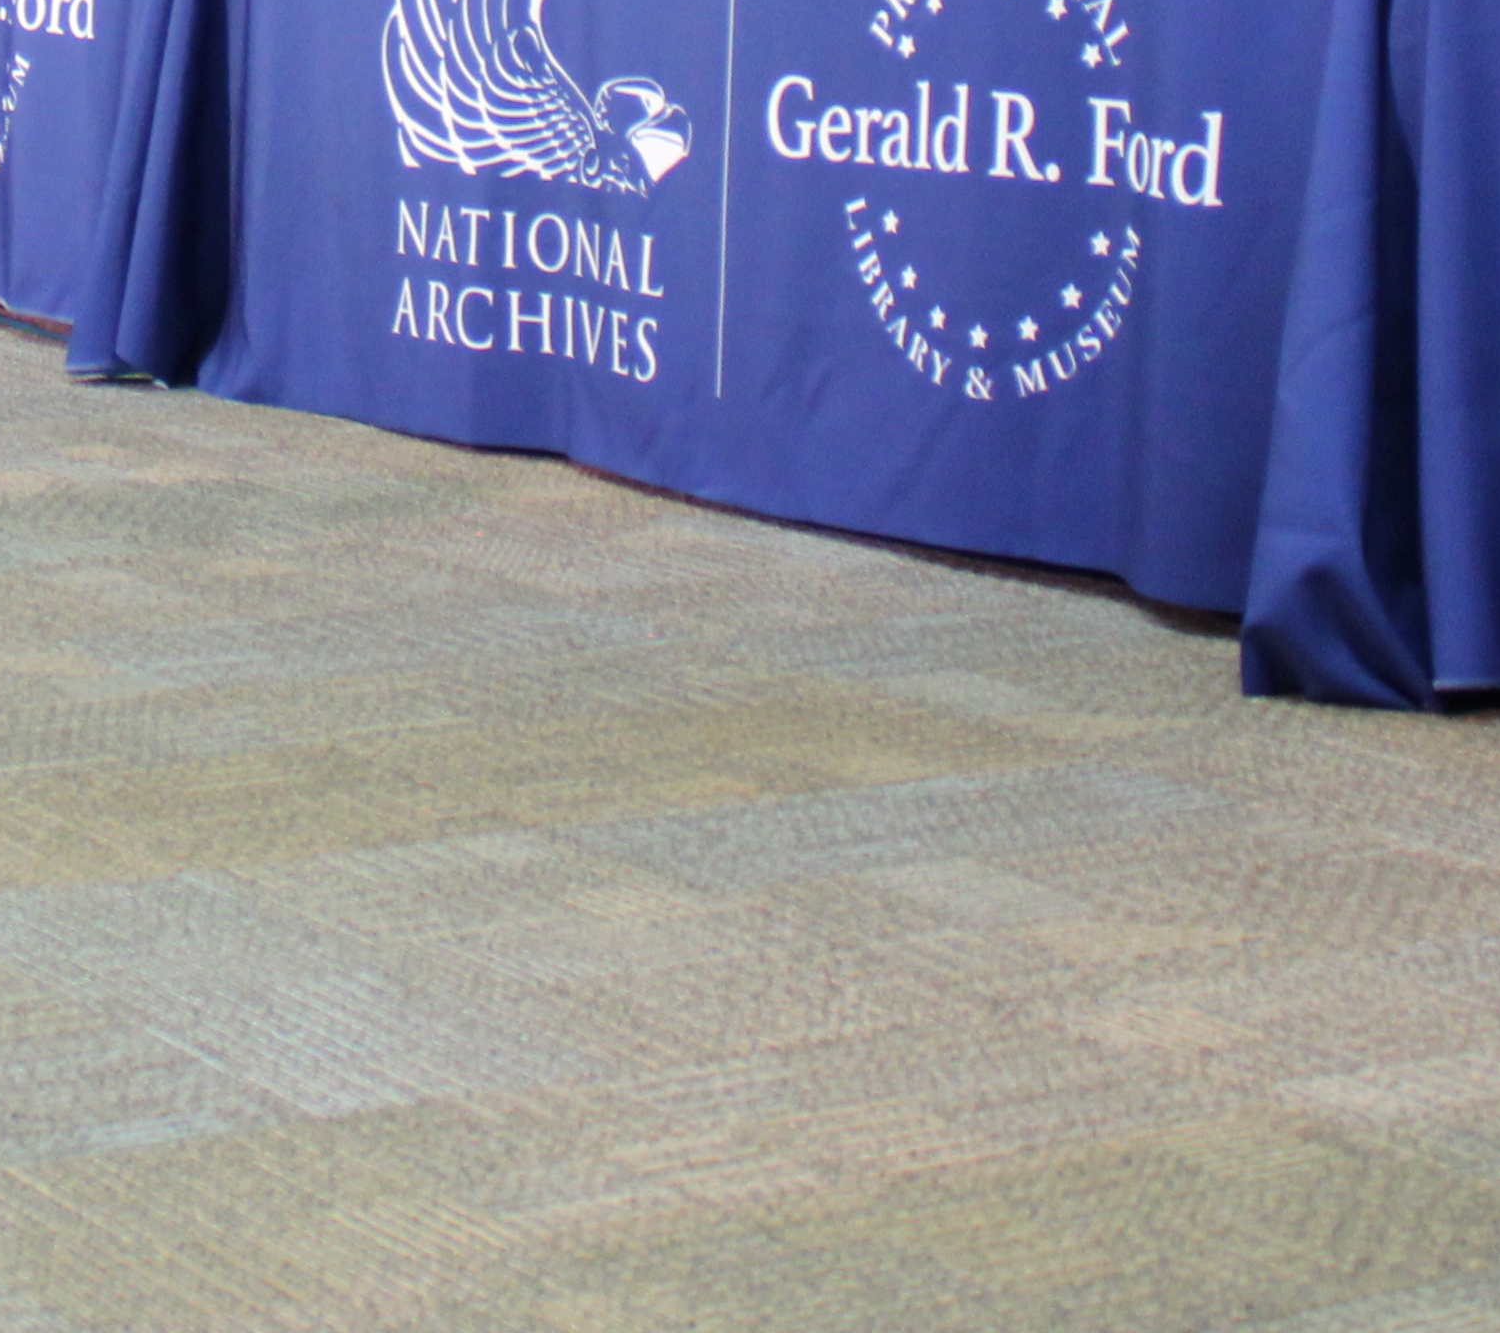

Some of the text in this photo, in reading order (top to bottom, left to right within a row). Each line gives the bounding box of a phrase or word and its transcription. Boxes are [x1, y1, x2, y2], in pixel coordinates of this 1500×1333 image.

[767, 75, 1222, 206] Gerald R. Ford
[395, 195, 667, 300] NATIONAL
[843, 195, 1144, 402] LIBRARY & MUSEUM
[390, 276, 661, 385] ARCHIVES
